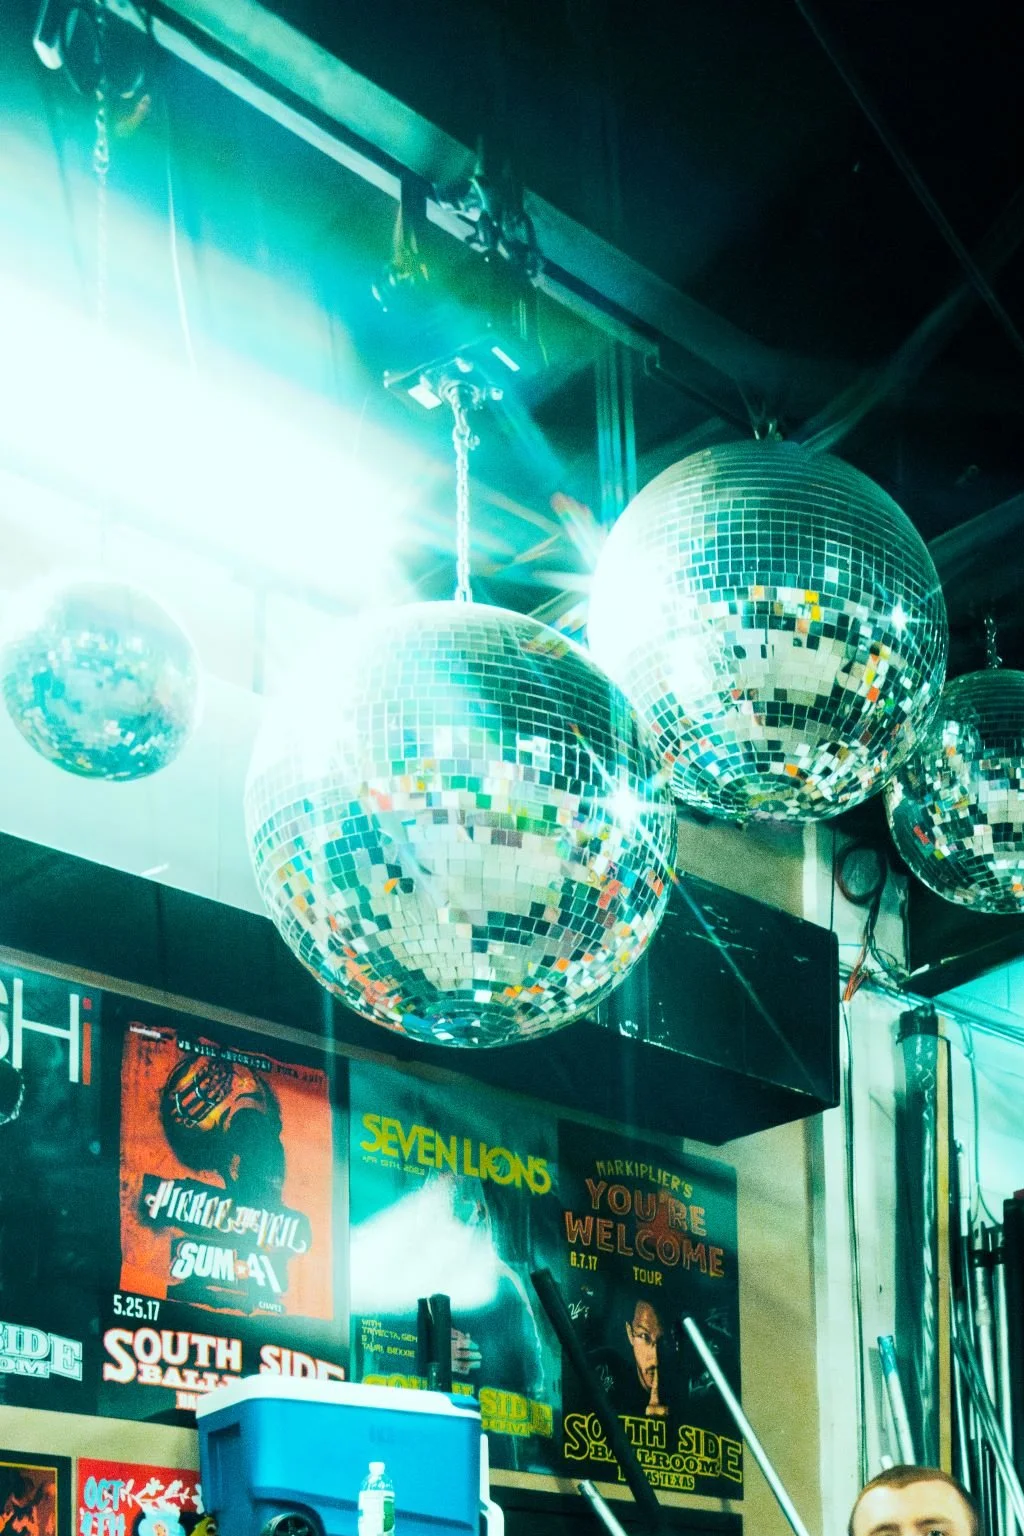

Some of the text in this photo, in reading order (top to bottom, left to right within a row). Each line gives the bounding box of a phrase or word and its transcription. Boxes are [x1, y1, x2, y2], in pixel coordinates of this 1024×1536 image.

[360, 1113, 552, 1195] SEVEN LIONS
[596, 1159, 693, 1199] MARKIPLIER'S
[585, 1178, 707, 1236] YOU'RE
[171, 1242, 283, 1294] SUM 41
[564, 1211, 725, 1277] WELCOME
[633, 1266, 663, 1286] TOUR
[113, 1294, 160, 1321] 5.25.17
[0, 1321, 83, 1381] IDE
[103, 1327, 243, 1384] SOUTH
[564, 1412, 666, 1460] SOTH
[678, 1425, 743, 1482] SIDE
[590, 1441, 720, 1477] BLROOM
[84, 1476, 125, 1511] OCT
[659, 1471, 695, 1490] TEXAS
